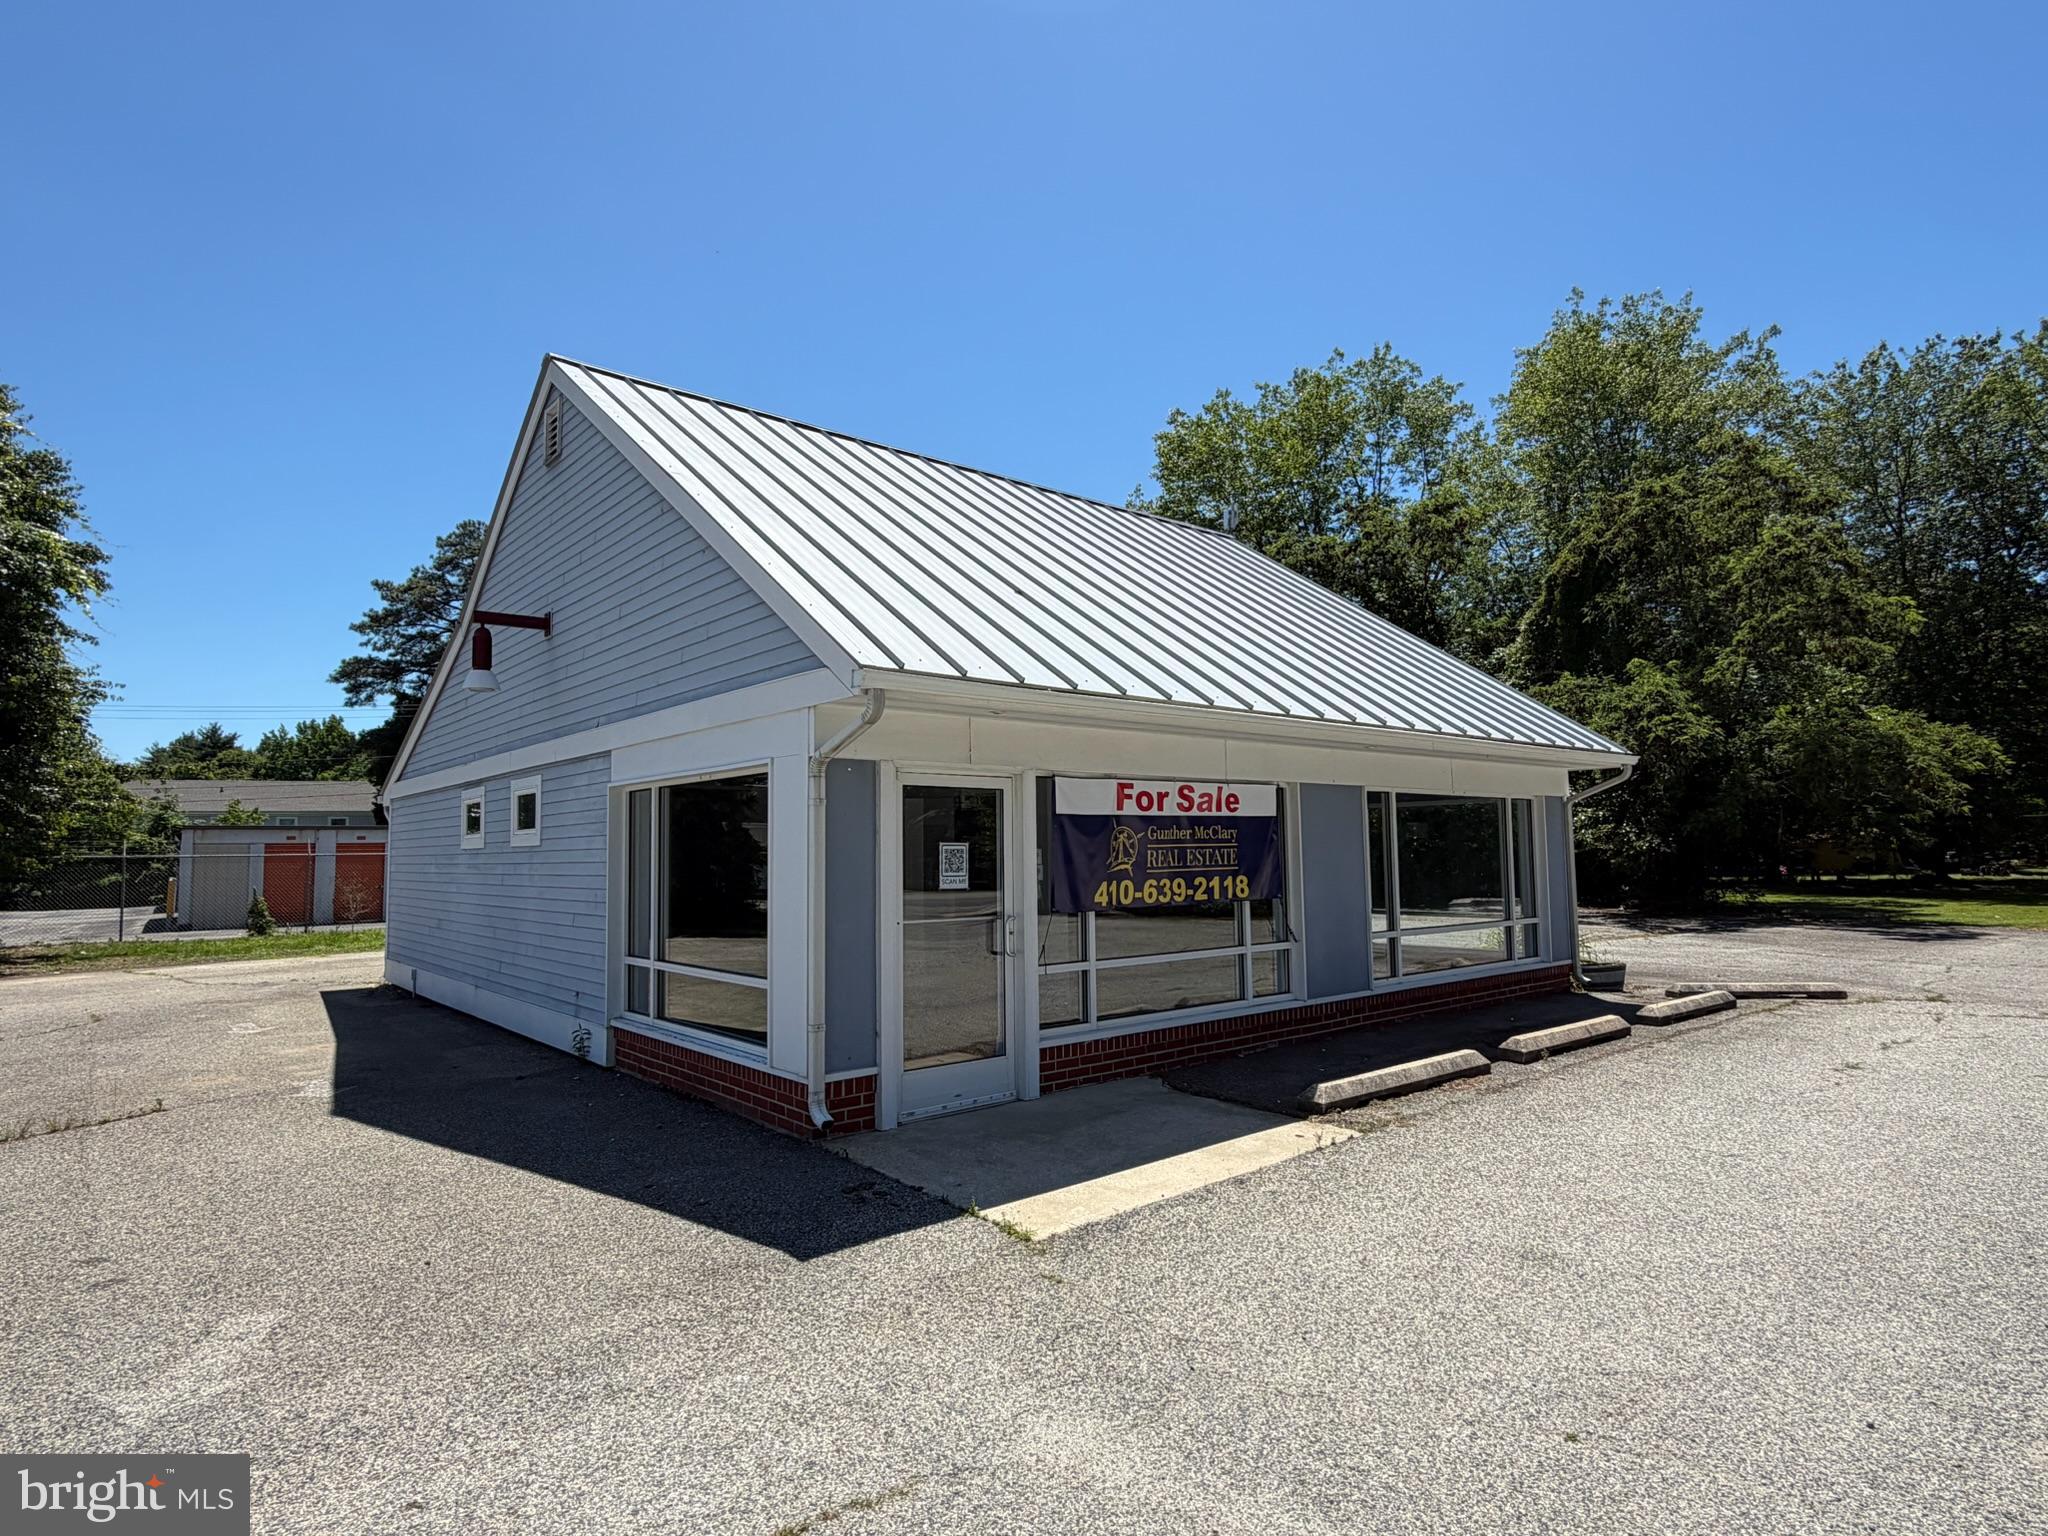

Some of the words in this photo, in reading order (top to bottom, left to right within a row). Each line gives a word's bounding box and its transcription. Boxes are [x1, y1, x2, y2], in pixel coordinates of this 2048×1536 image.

[1116, 782, 1170, 812] For
[1176, 784, 1240, 813] Sale
[1147, 825, 1193, 841] Gunther
[1194, 825, 1238, 843] McClary
[1147, 849, 1183, 868] REAL
[1187, 848, 1238, 866] ESTATE
[1094, 874, 1249, 907] 410-639-2118
